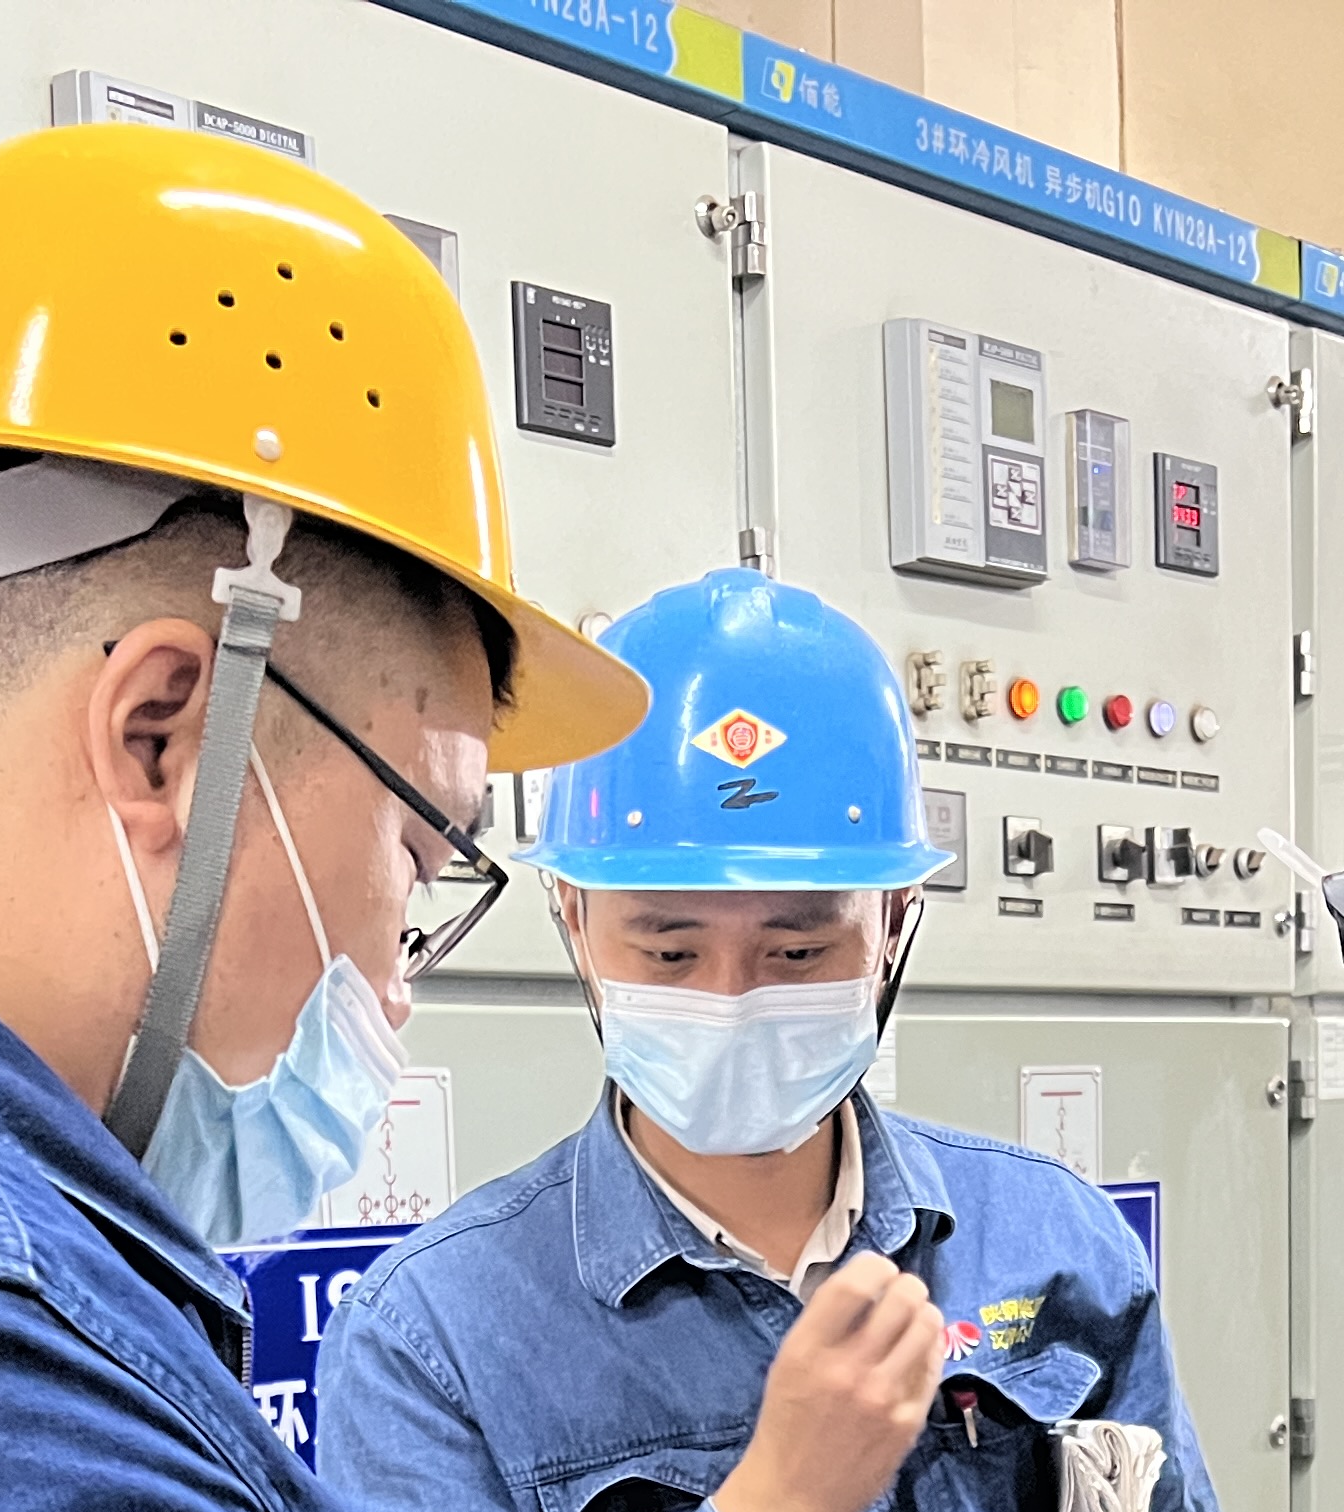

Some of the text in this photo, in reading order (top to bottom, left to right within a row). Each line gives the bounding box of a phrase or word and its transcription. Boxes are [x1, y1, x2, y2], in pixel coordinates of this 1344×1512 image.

[204, 112, 300, 151] DCAP-5000 DIGITAL
[915, 117, 1248, 268] 3#环冷风机 异步机G10 KYN28A-12
